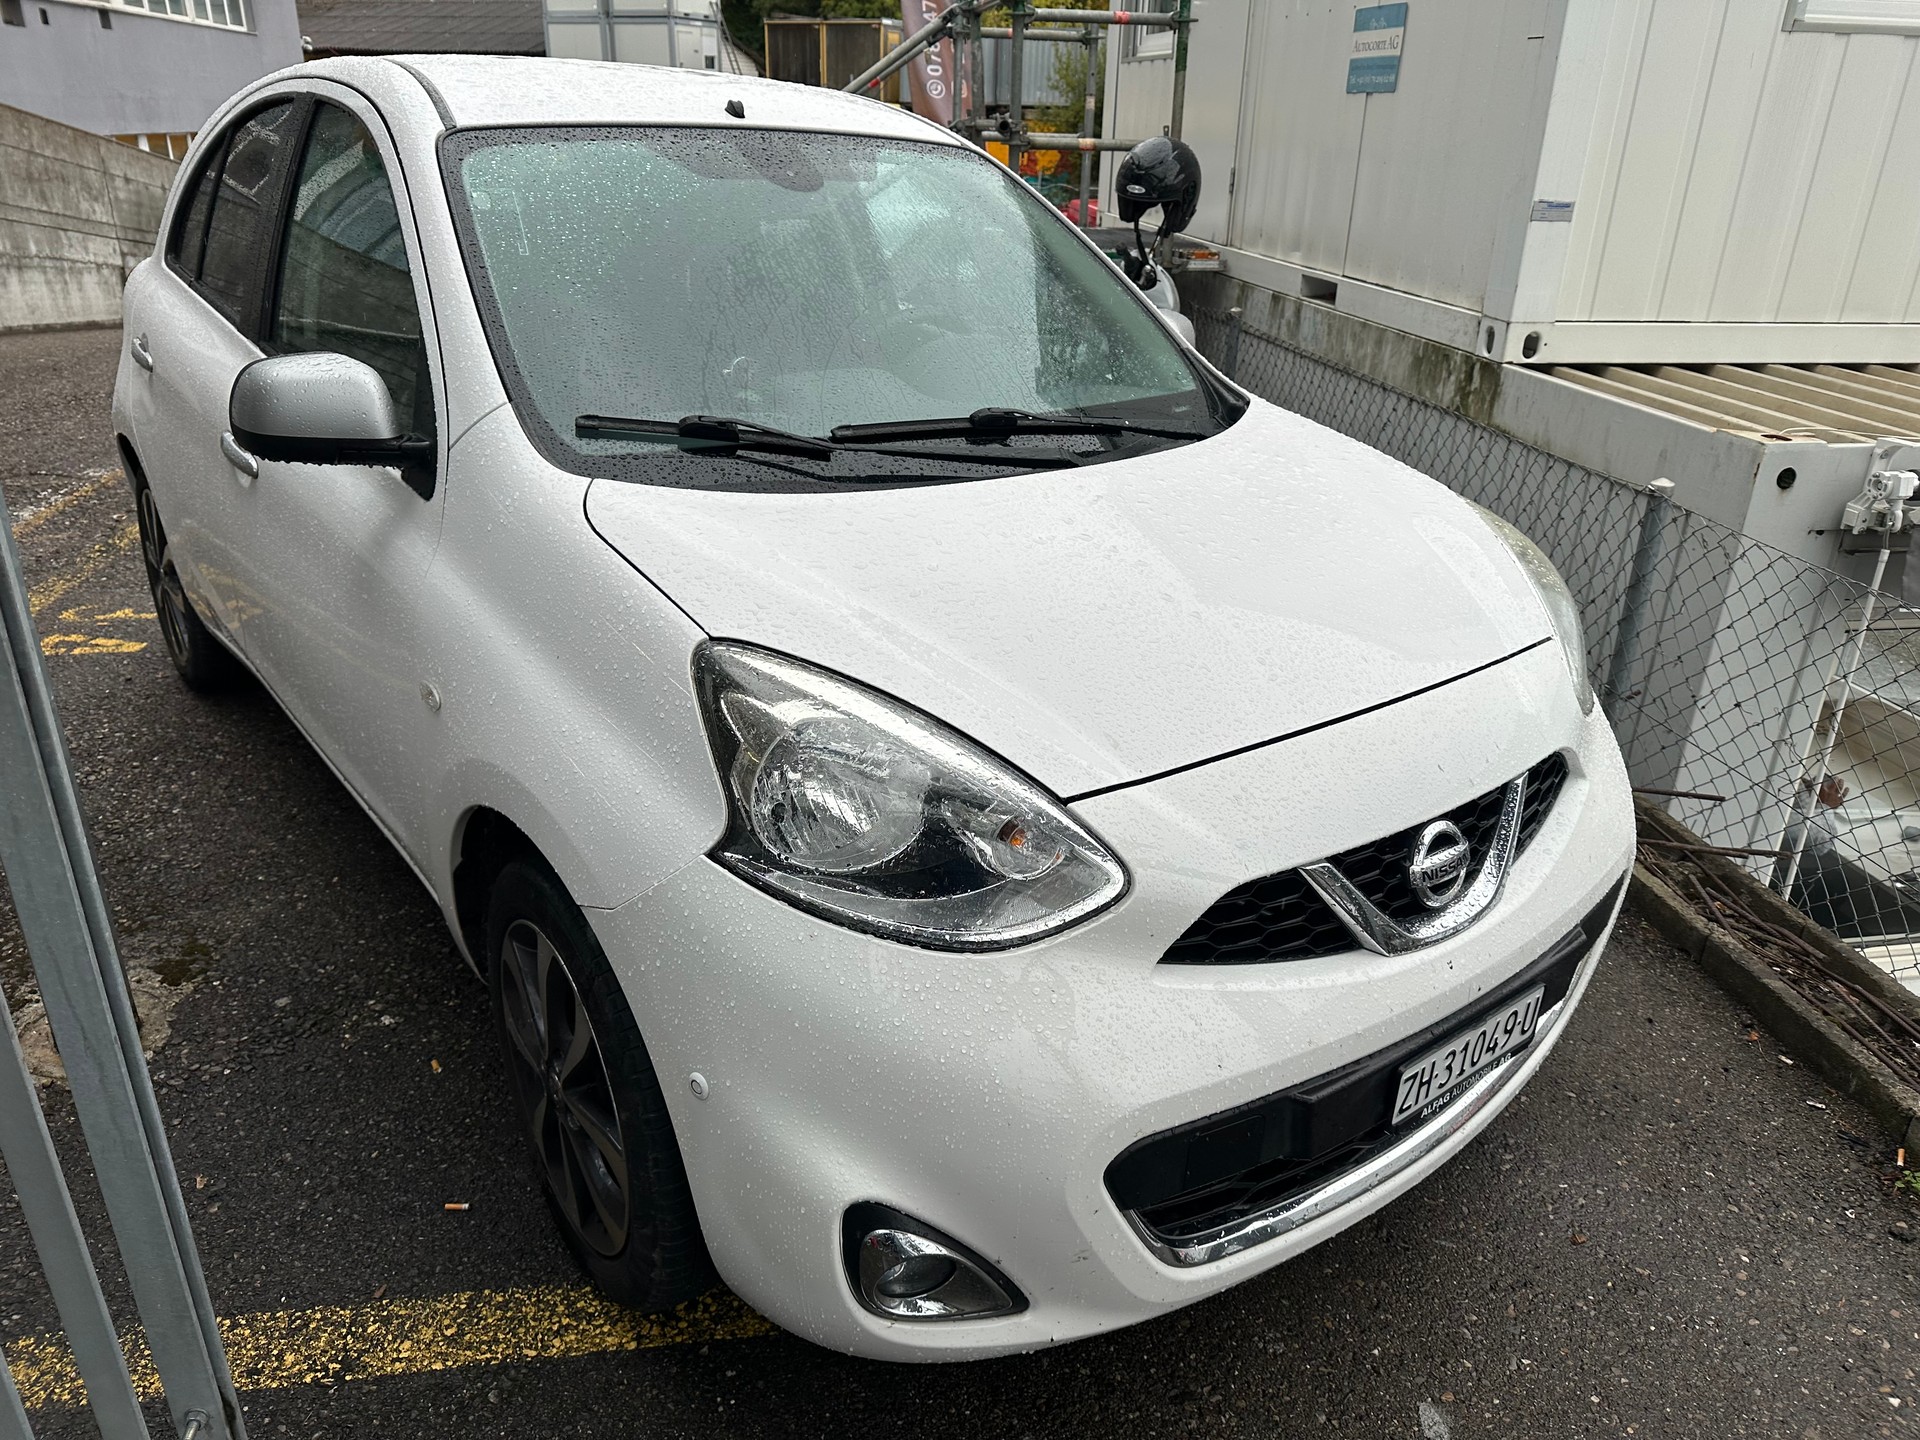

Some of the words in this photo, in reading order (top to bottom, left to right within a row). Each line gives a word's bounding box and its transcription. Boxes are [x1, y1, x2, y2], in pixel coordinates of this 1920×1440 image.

[1386, 34, 1400, 50] AG
[1421, 852, 1468, 883] NISSAN
[1420, 1092, 1451, 1119] ALFAG
[1451, 1061, 1498, 1099] AUTOMOBILE
[1499, 1052, 1512, 1067] AG
